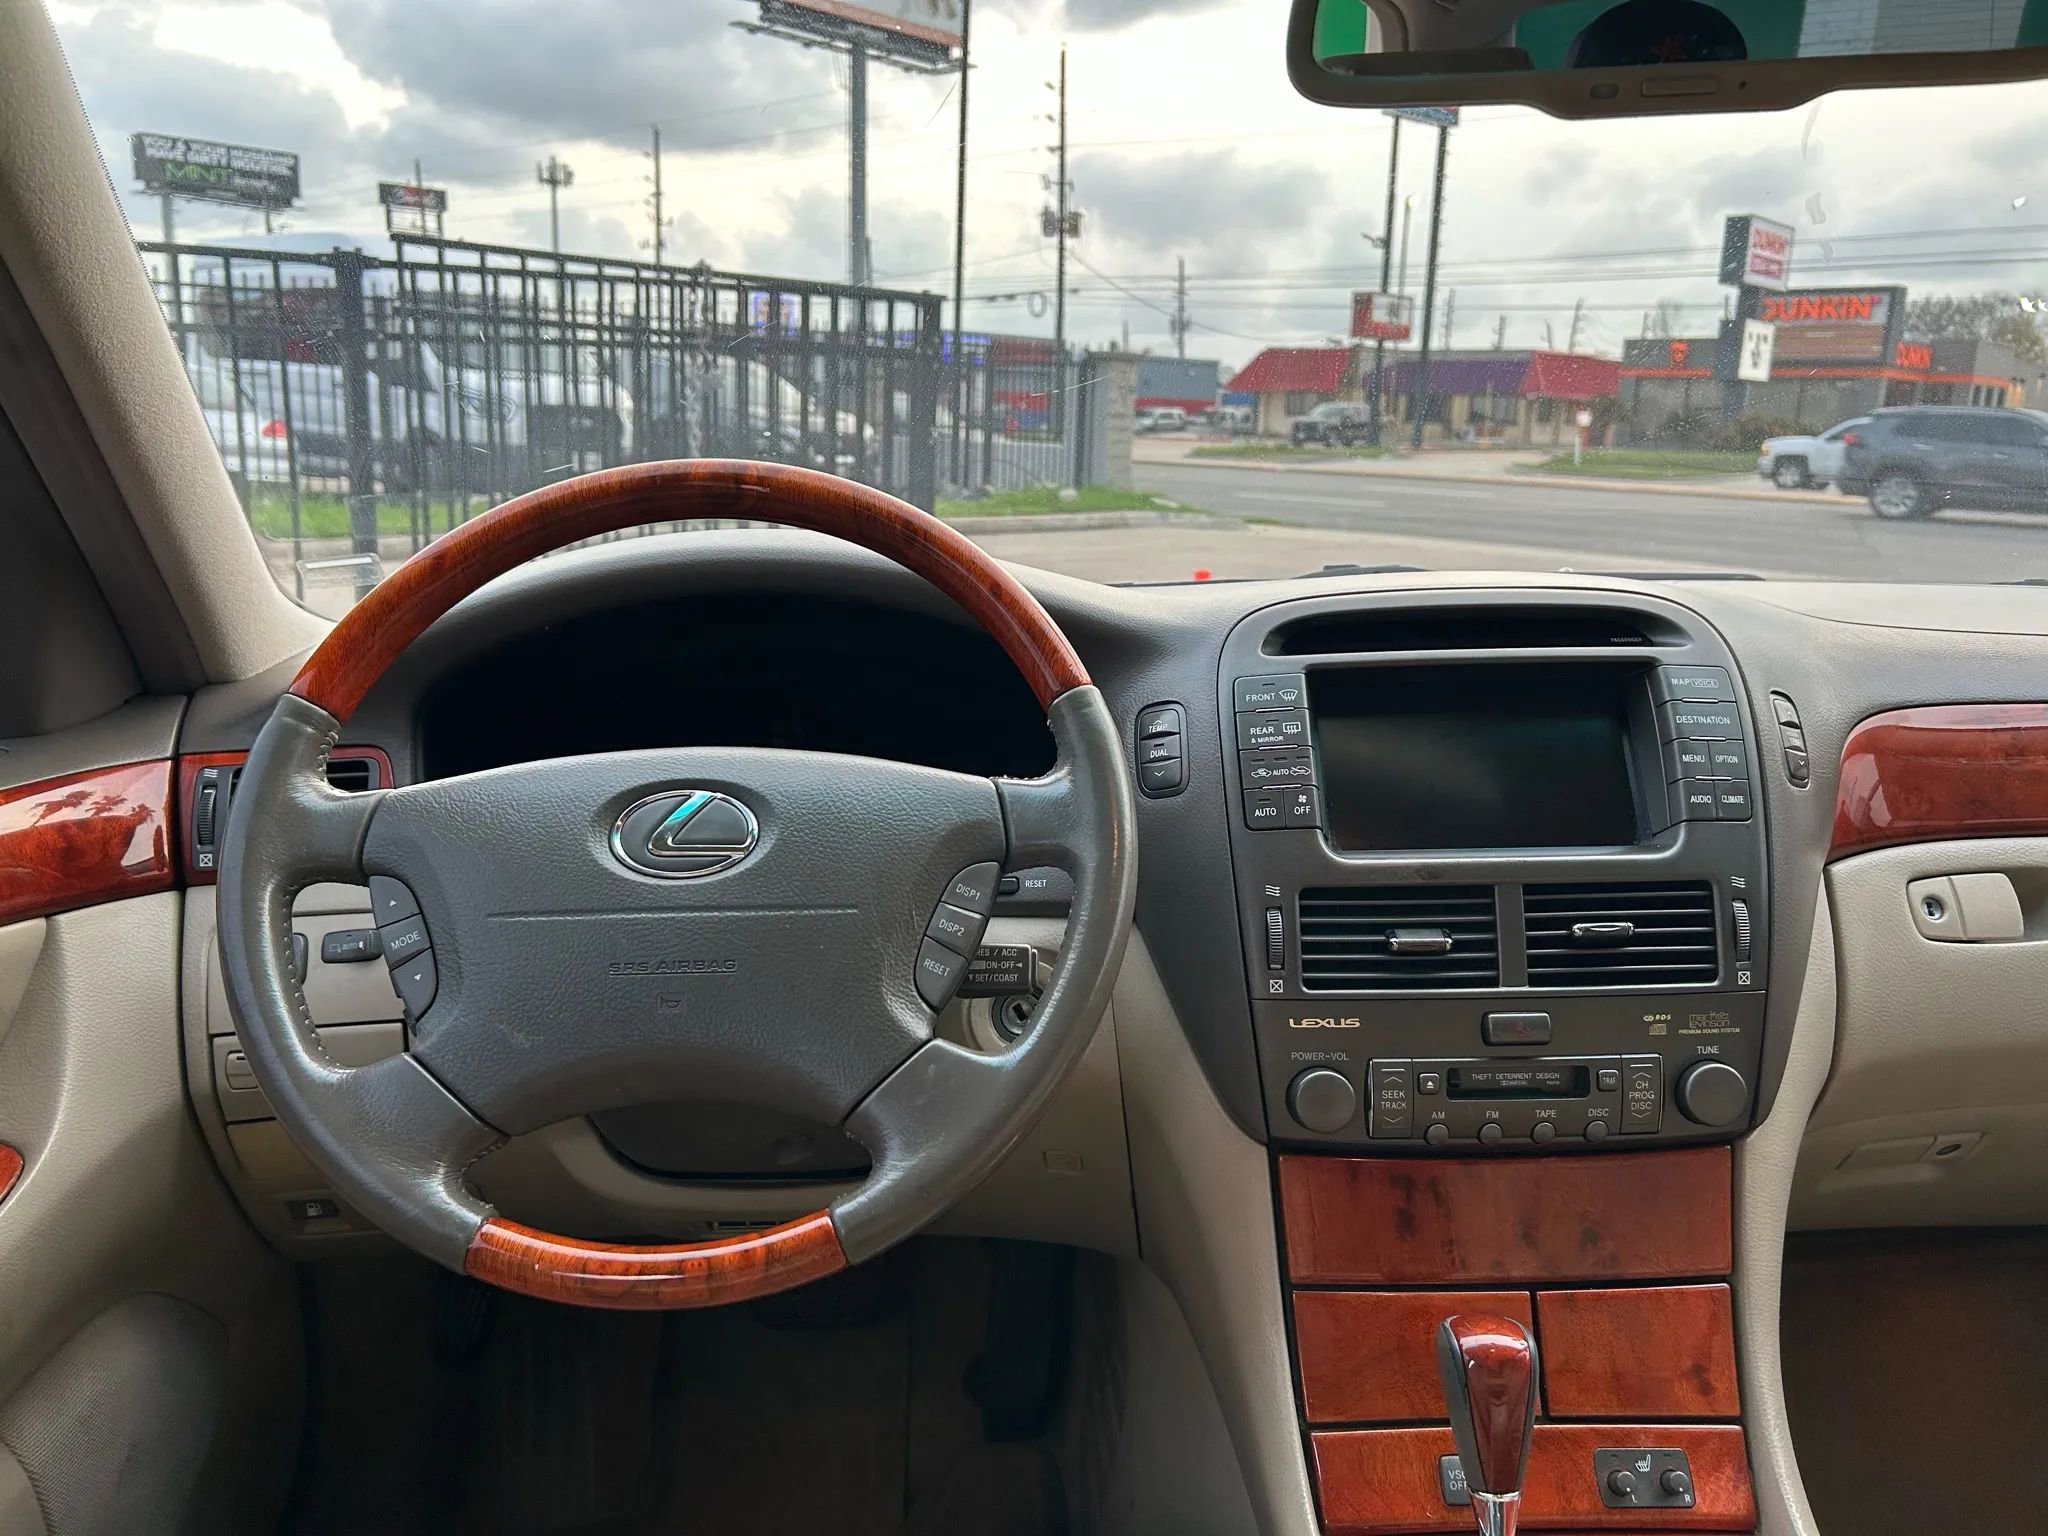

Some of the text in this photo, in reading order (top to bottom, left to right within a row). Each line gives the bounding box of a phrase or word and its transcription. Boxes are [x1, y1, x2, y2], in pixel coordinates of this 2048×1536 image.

[1671, 678, 1717, 687] MAP VOICE
[1246, 692, 1275, 702] FRONT
[1676, 715, 1730, 725] DESTINATION
[1148, 724, 1168, 733] TEMP
[1250, 726, 1274, 735] REAR
[1258, 735, 1284, 743] MIRROR
[1150, 748, 1168, 758] DUAL
[1682, 754, 1705, 763] MENU
[1715, 755, 1738, 764] OPTION
[1272, 768, 1289, 776] AUTO
[1690, 795, 1712, 804] AUDIO
[1721, 795, 1744, 804] CLIMATE
[1254, 807, 1277, 817] AUTO
[1293, 805, 1311, 815] OFF
[1025, 879, 1047, 888] RESET
[955, 883, 981, 901] DISP1
[938, 919, 965, 937] DISP2
[390, 930, 421, 950] MODE
[1001, 948, 1017, 957] ACC
[609, 959, 738, 974] SRS AIRBAG
[923, 958, 951, 977] RESET
[986, 961, 1015, 969] ON-OFF
[975, 973, 1019, 982] SET/COAST
[1289, 1018, 1360, 1028] LEXUS
[1696, 1045, 1719, 1054] TUNE
[1495, 1072, 1533, 1080] DETERRENT
[1382, 1090, 1406, 1099] SEEK
[1629, 1091, 1654, 1099] PROG
[1381, 1101, 1407, 1109] TRACK
[1630, 1102, 1652, 1110] DISC
[1431, 1111, 1445, 1119] AM
[1535, 1109, 1556, 1117] TAPE
[1588, 1108, 1609, 1116] DISC
[1631, 1494, 1638, 1503] L
[1684, 1494, 1692, 1503] R
